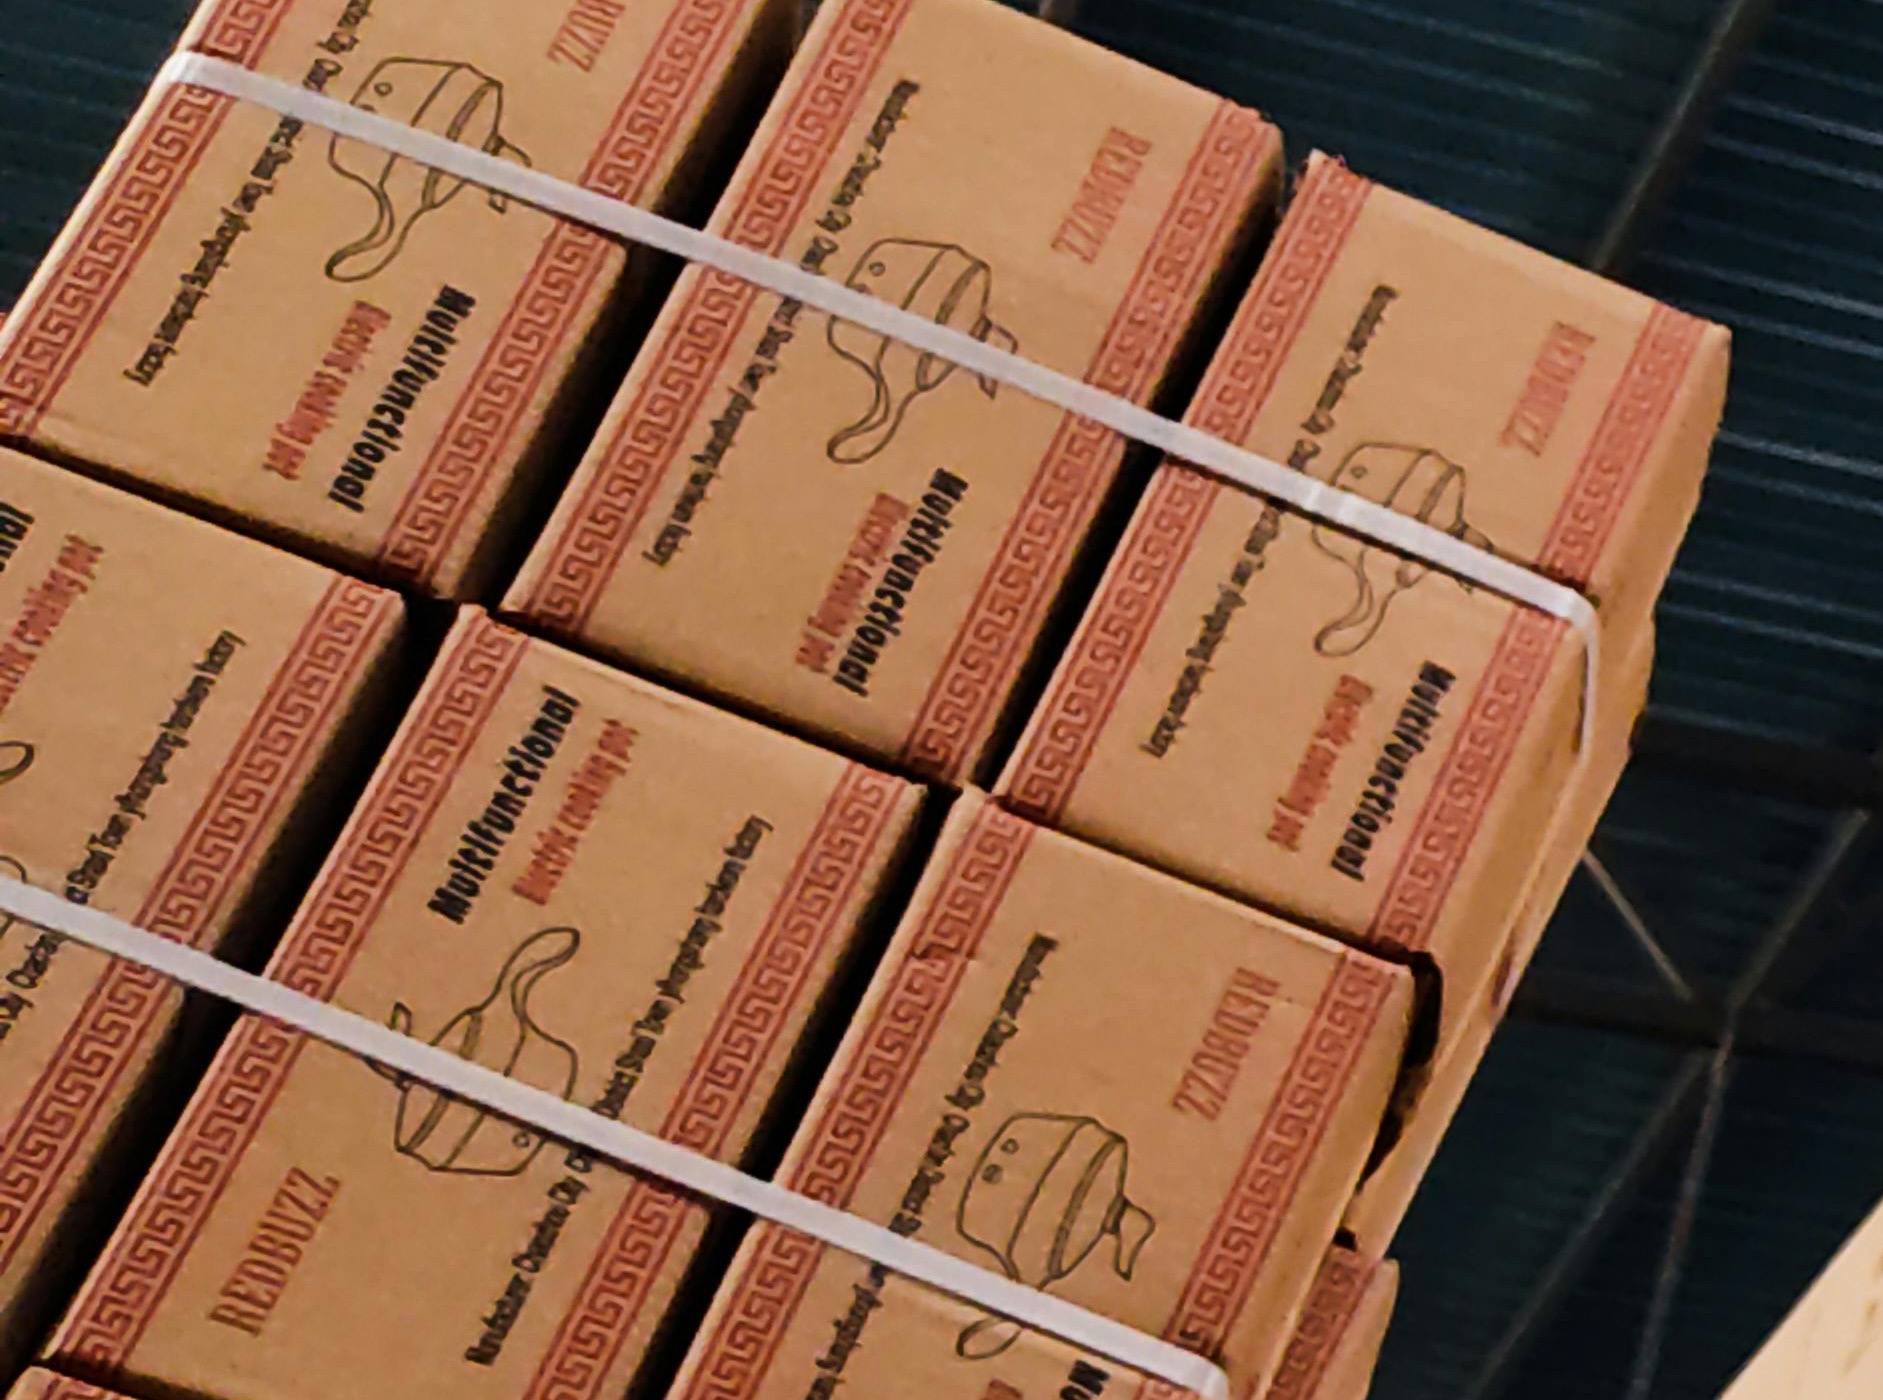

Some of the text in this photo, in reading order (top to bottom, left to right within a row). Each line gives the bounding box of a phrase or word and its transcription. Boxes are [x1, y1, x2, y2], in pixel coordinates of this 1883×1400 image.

[328, 285, 475, 513] Multifunctional
[833, 468, 968, 697] Multifunctional
[427, 686, 580, 924] Multifunctional
[1330, 662, 1455, 882] Multifunctional
[1171, 967, 1280, 1121] REDBUZZ
[208, 1167, 340, 1336] REDBUZZ
